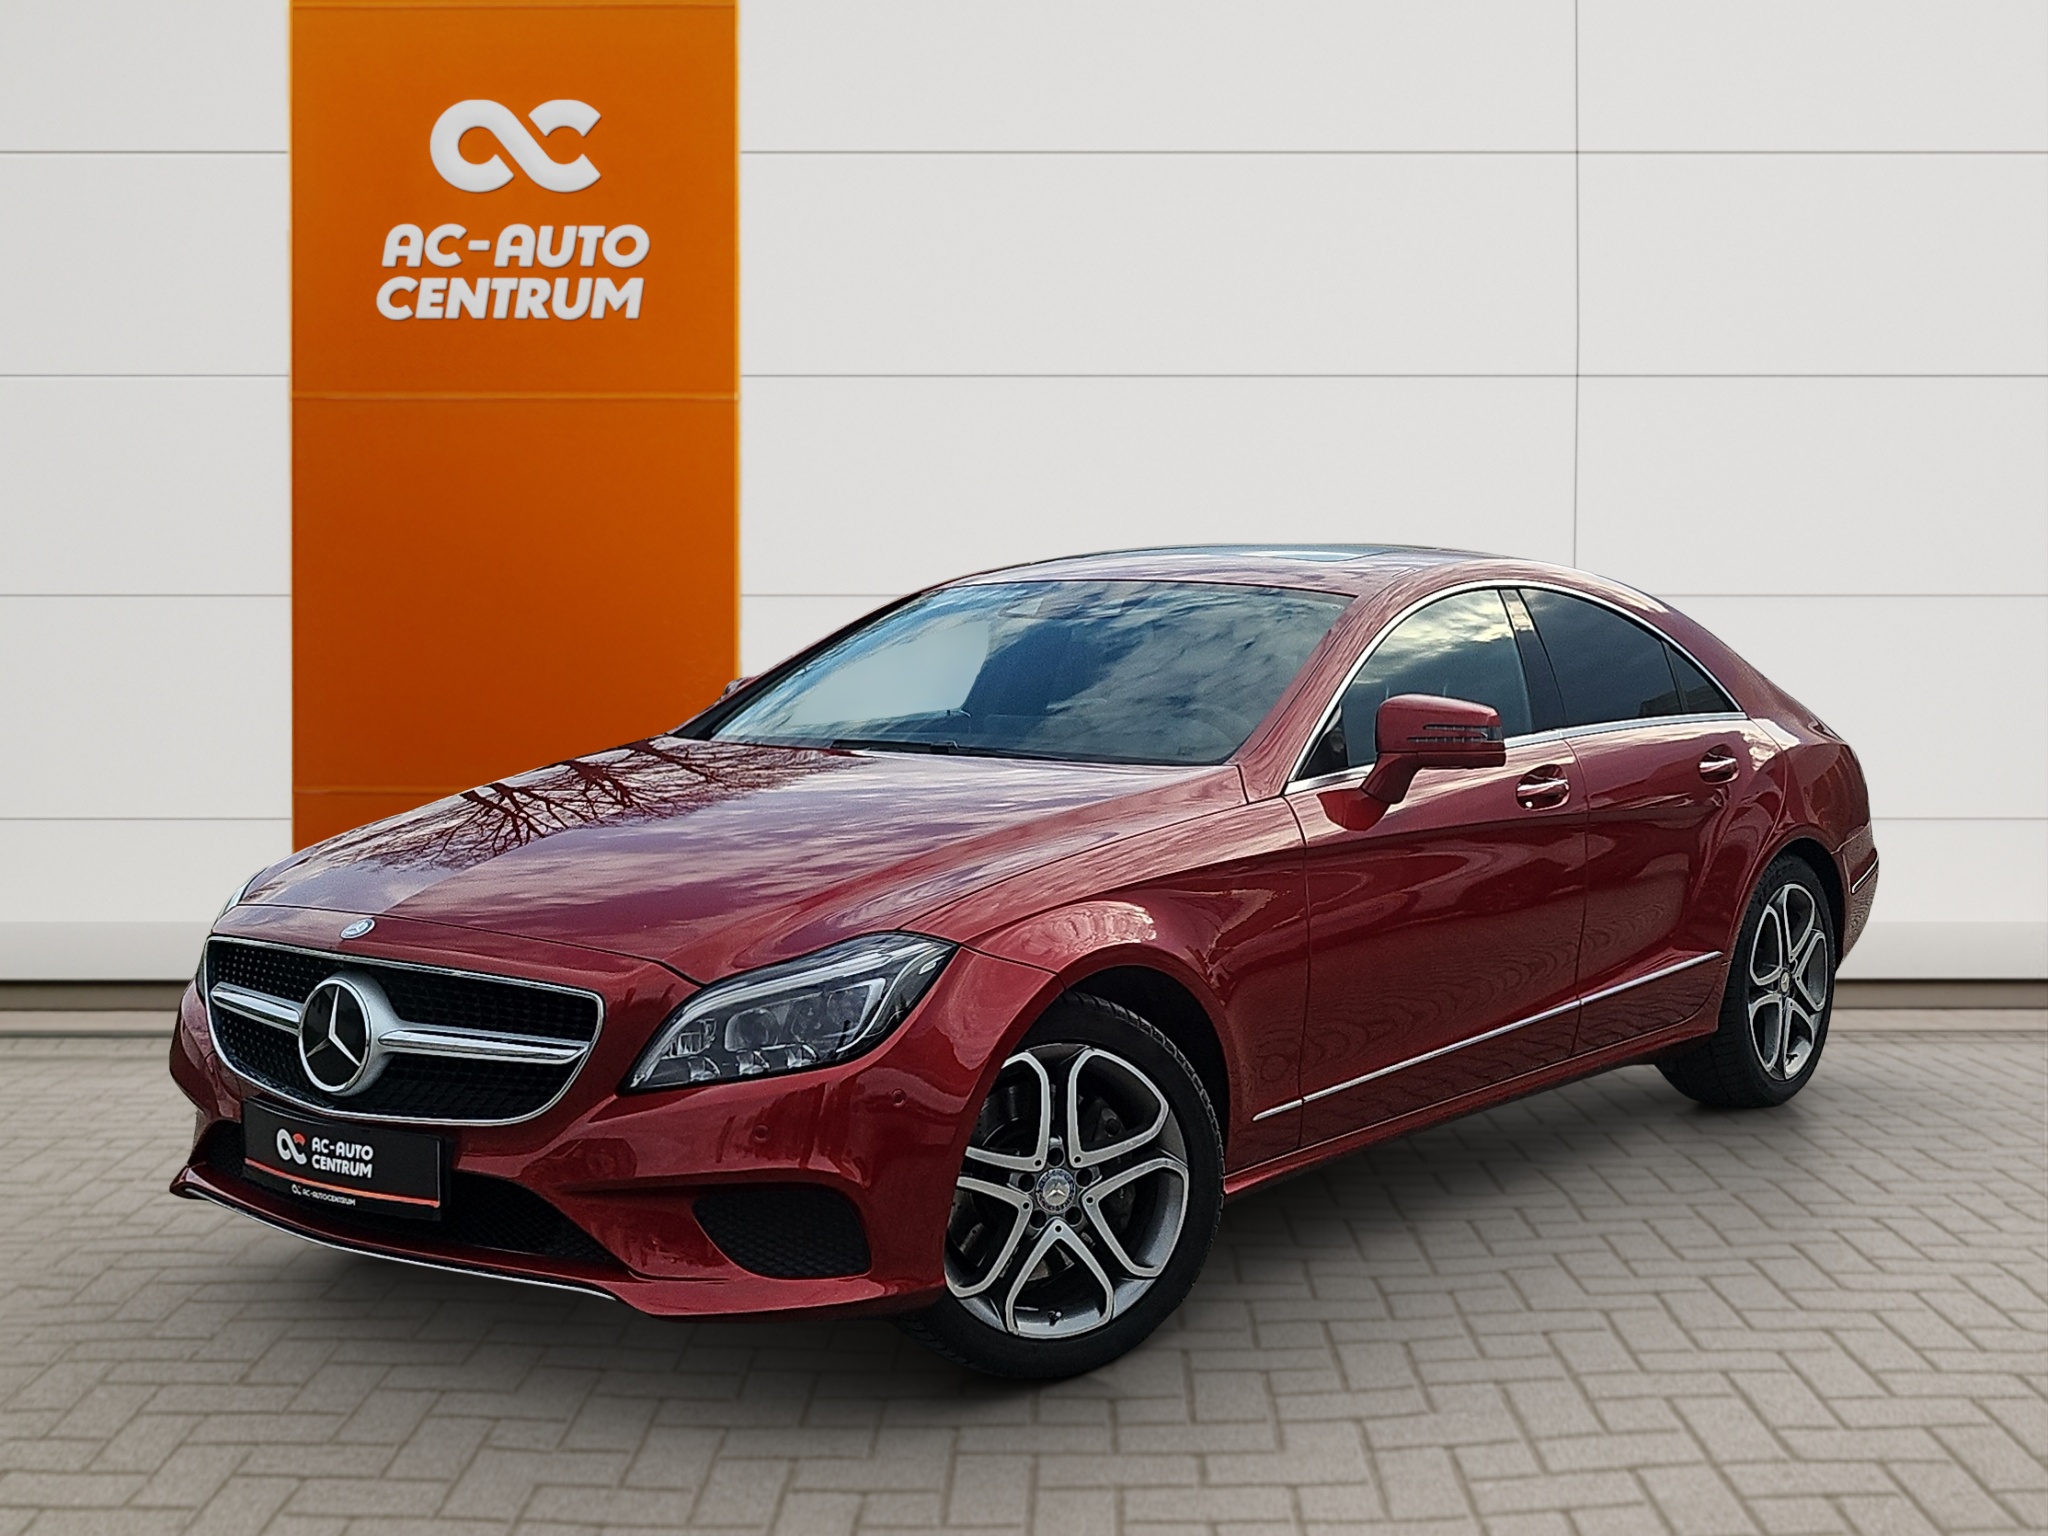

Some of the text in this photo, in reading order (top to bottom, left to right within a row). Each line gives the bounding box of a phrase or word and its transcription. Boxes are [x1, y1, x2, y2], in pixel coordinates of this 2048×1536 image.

[382, 223, 650, 268] AC-AUTO
[376, 276, 644, 321] CENTRUM
[311, 1137, 373, 1160] AC-AUTO
[311, 1155, 373, 1178] CENTRUM
